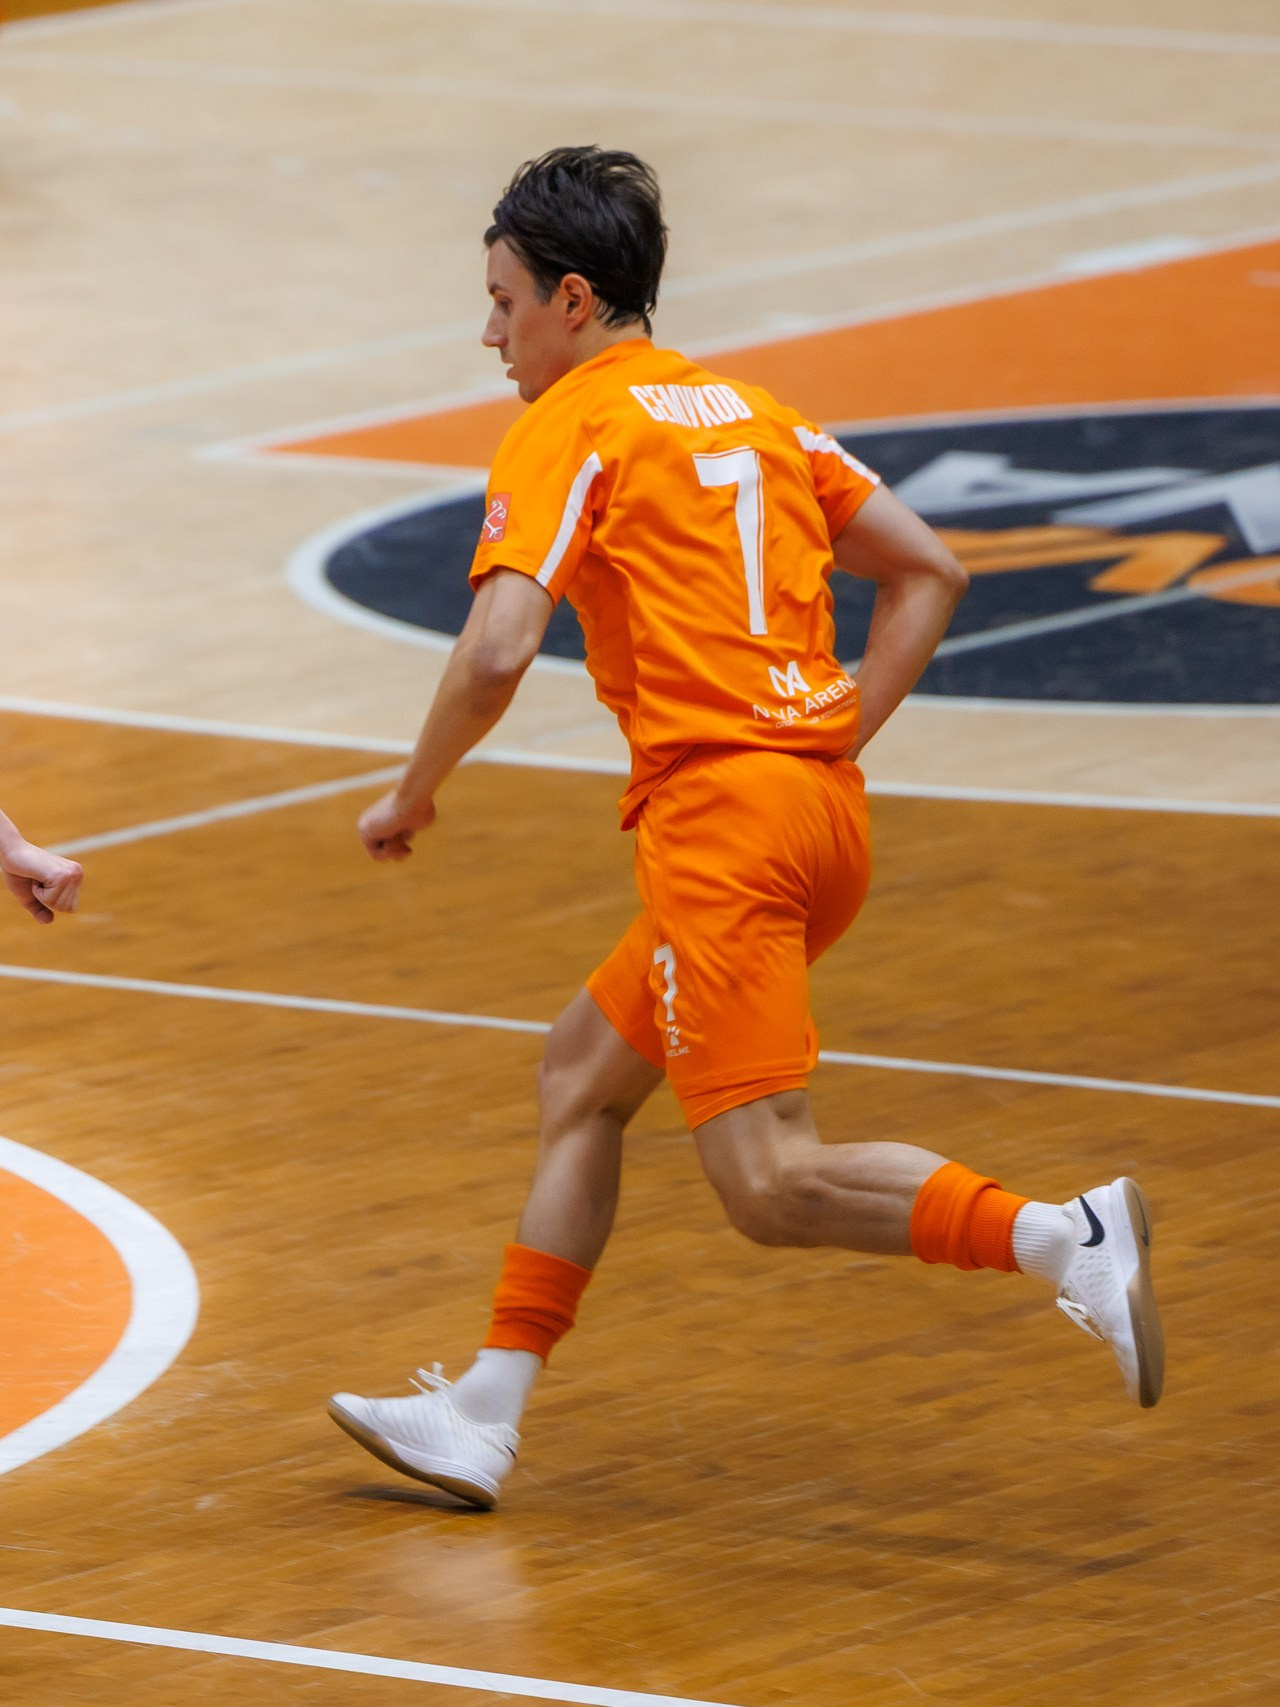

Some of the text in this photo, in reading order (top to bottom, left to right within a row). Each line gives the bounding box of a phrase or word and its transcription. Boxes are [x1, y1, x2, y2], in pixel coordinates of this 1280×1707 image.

[692, 445, 768, 635] 7
[753, 704, 802, 720] NVA
[805, 675, 857, 715] AREN
[653, 943, 677, 1022] 7
